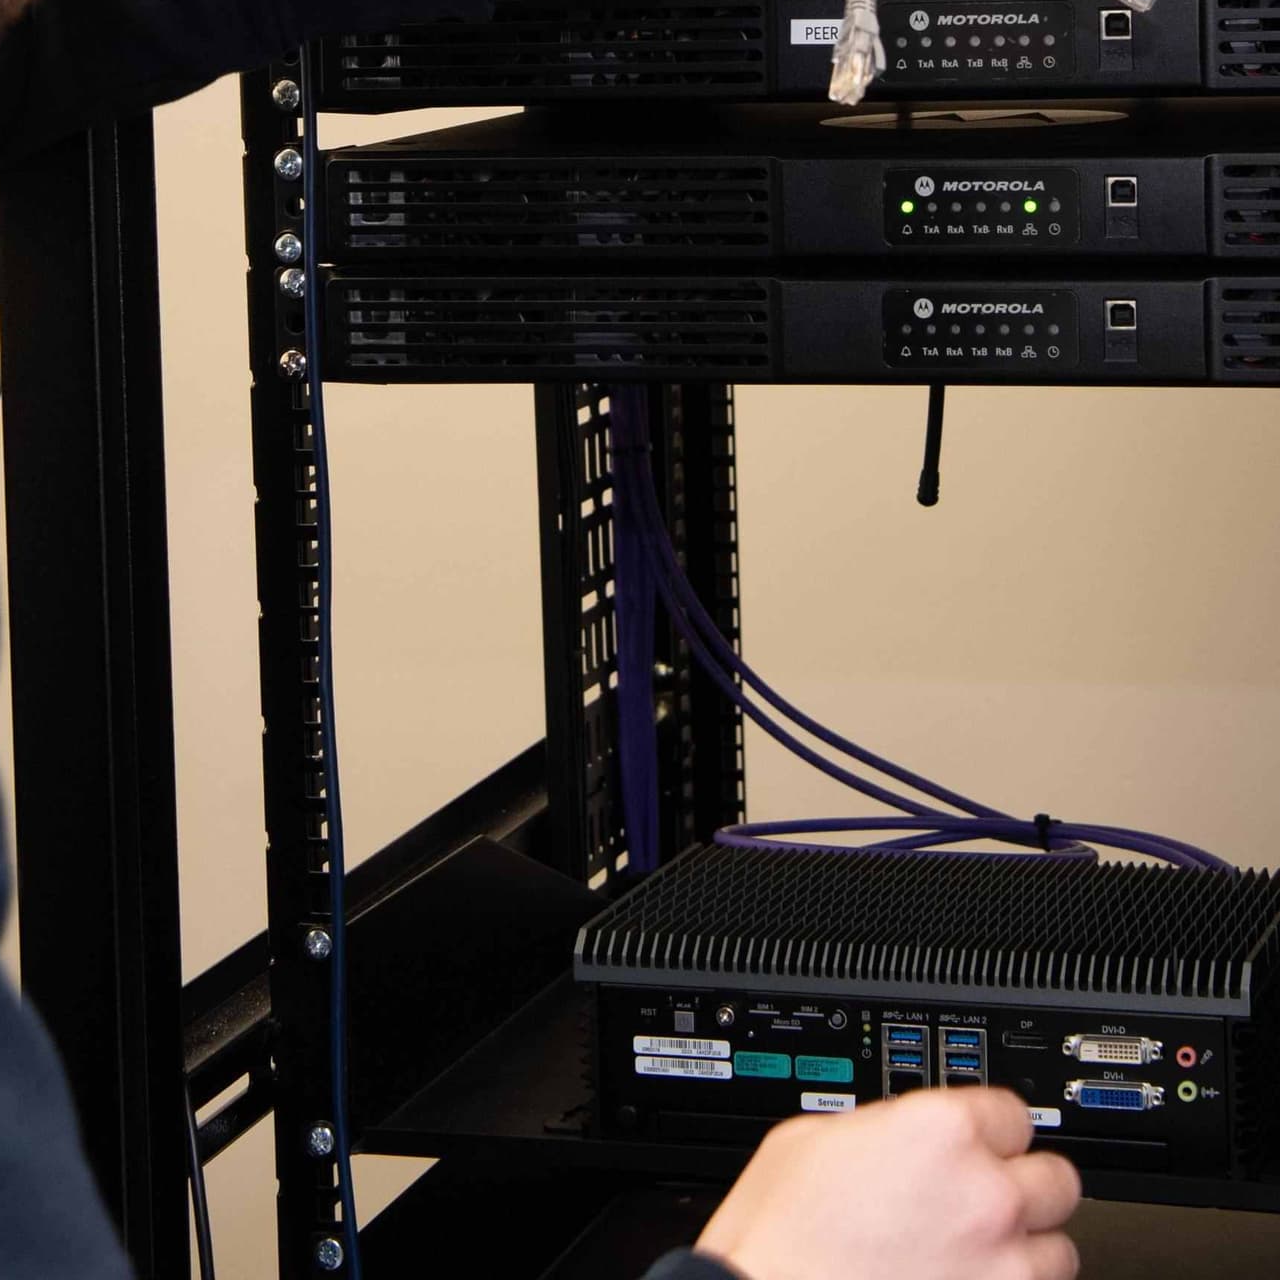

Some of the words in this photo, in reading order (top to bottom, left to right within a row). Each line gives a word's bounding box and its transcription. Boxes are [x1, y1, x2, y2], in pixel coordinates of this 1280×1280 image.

[937, 14, 1039, 26] MOTOROLA
[805, 26, 838, 40] PEER
[918, 59, 934, 68] TxA
[942, 59, 959, 68] RxA
[967, 58, 983, 68] TxB
[991, 58, 1008, 68] RxB
[942, 180, 1045, 192] MOTOROLA
[923, 225, 940, 234] TxA
[947, 225, 964, 234] RxA
[972, 225, 989, 234] TxB
[996, 225, 1014, 234] RxB
[941, 303, 1044, 314] MOTOROLA
[922, 347, 939, 356] TxA
[946, 347, 963, 356] RxA
[971, 347, 988, 356] TxB
[995, 347, 1013, 356] RxB
[640, 1008, 657, 1016] RST
[906, 1012, 921, 1021] LAN
[963, 1016, 978, 1024] LAN
[981, 1017, 986, 1025] 2
[1020, 1020, 1032, 1029] DP
[1101, 1025, 1126, 1034] DVI-D
[1103, 1071, 1123, 1081] DVI-I
[816, 1097, 845, 1108] Service
[1031, 1112, 1043, 1121] UX
